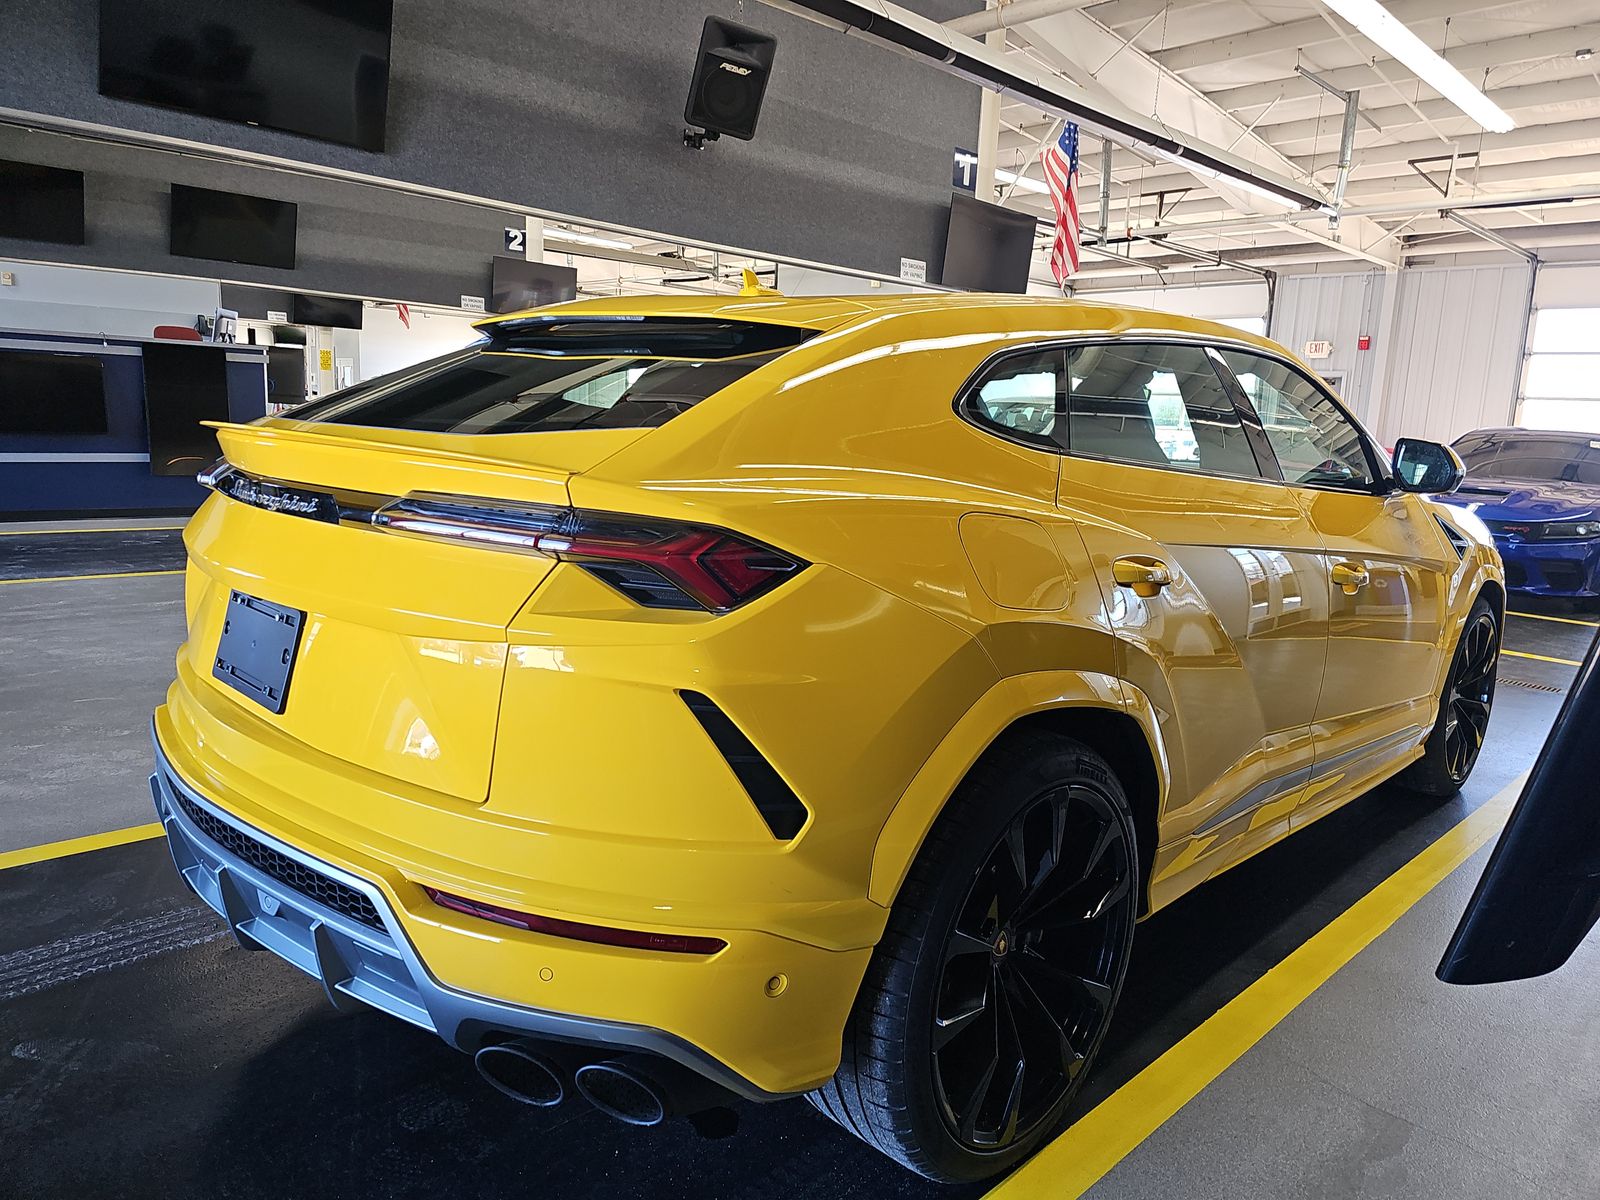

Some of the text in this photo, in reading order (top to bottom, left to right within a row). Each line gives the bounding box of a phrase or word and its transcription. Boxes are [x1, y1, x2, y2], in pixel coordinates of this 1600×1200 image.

[508, 229, 524, 252] 2
[908, 262, 925, 271] SMOKING
[1309, 342, 1325, 354] EXIT
